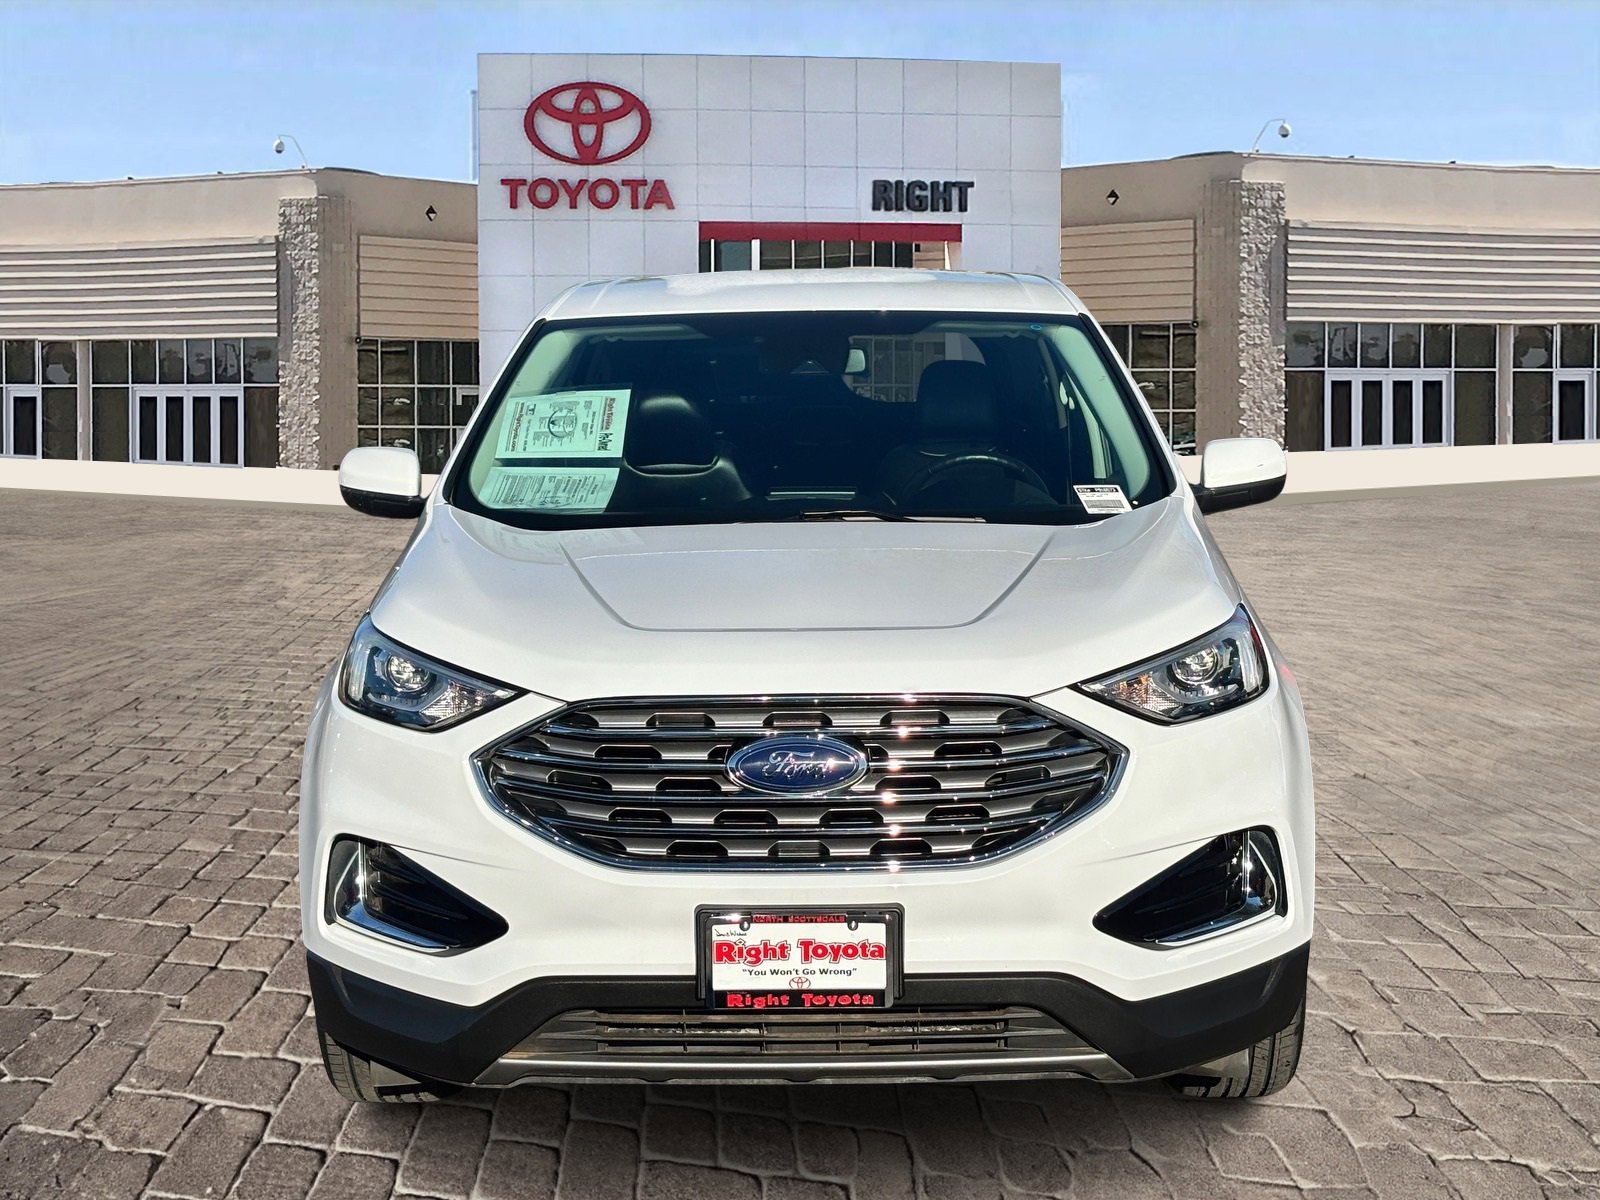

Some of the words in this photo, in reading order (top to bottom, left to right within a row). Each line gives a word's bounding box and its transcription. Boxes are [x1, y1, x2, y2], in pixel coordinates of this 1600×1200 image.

[500, 178, 676, 210] TOYOTA
[871, 179, 975, 212] RIGHT
[762, 750, 834, 779] Ford
[713, 938, 791, 966] Right
[797, 939, 886, 964] Toyota
[742, 968, 766, 976] "You
[769, 968, 800, 976] Won't
[802, 968, 816, 976] Go
[818, 968, 857, 976] Wrong"
[727, 993, 790, 1009] Right
[801, 993, 874, 1007] Toyota
